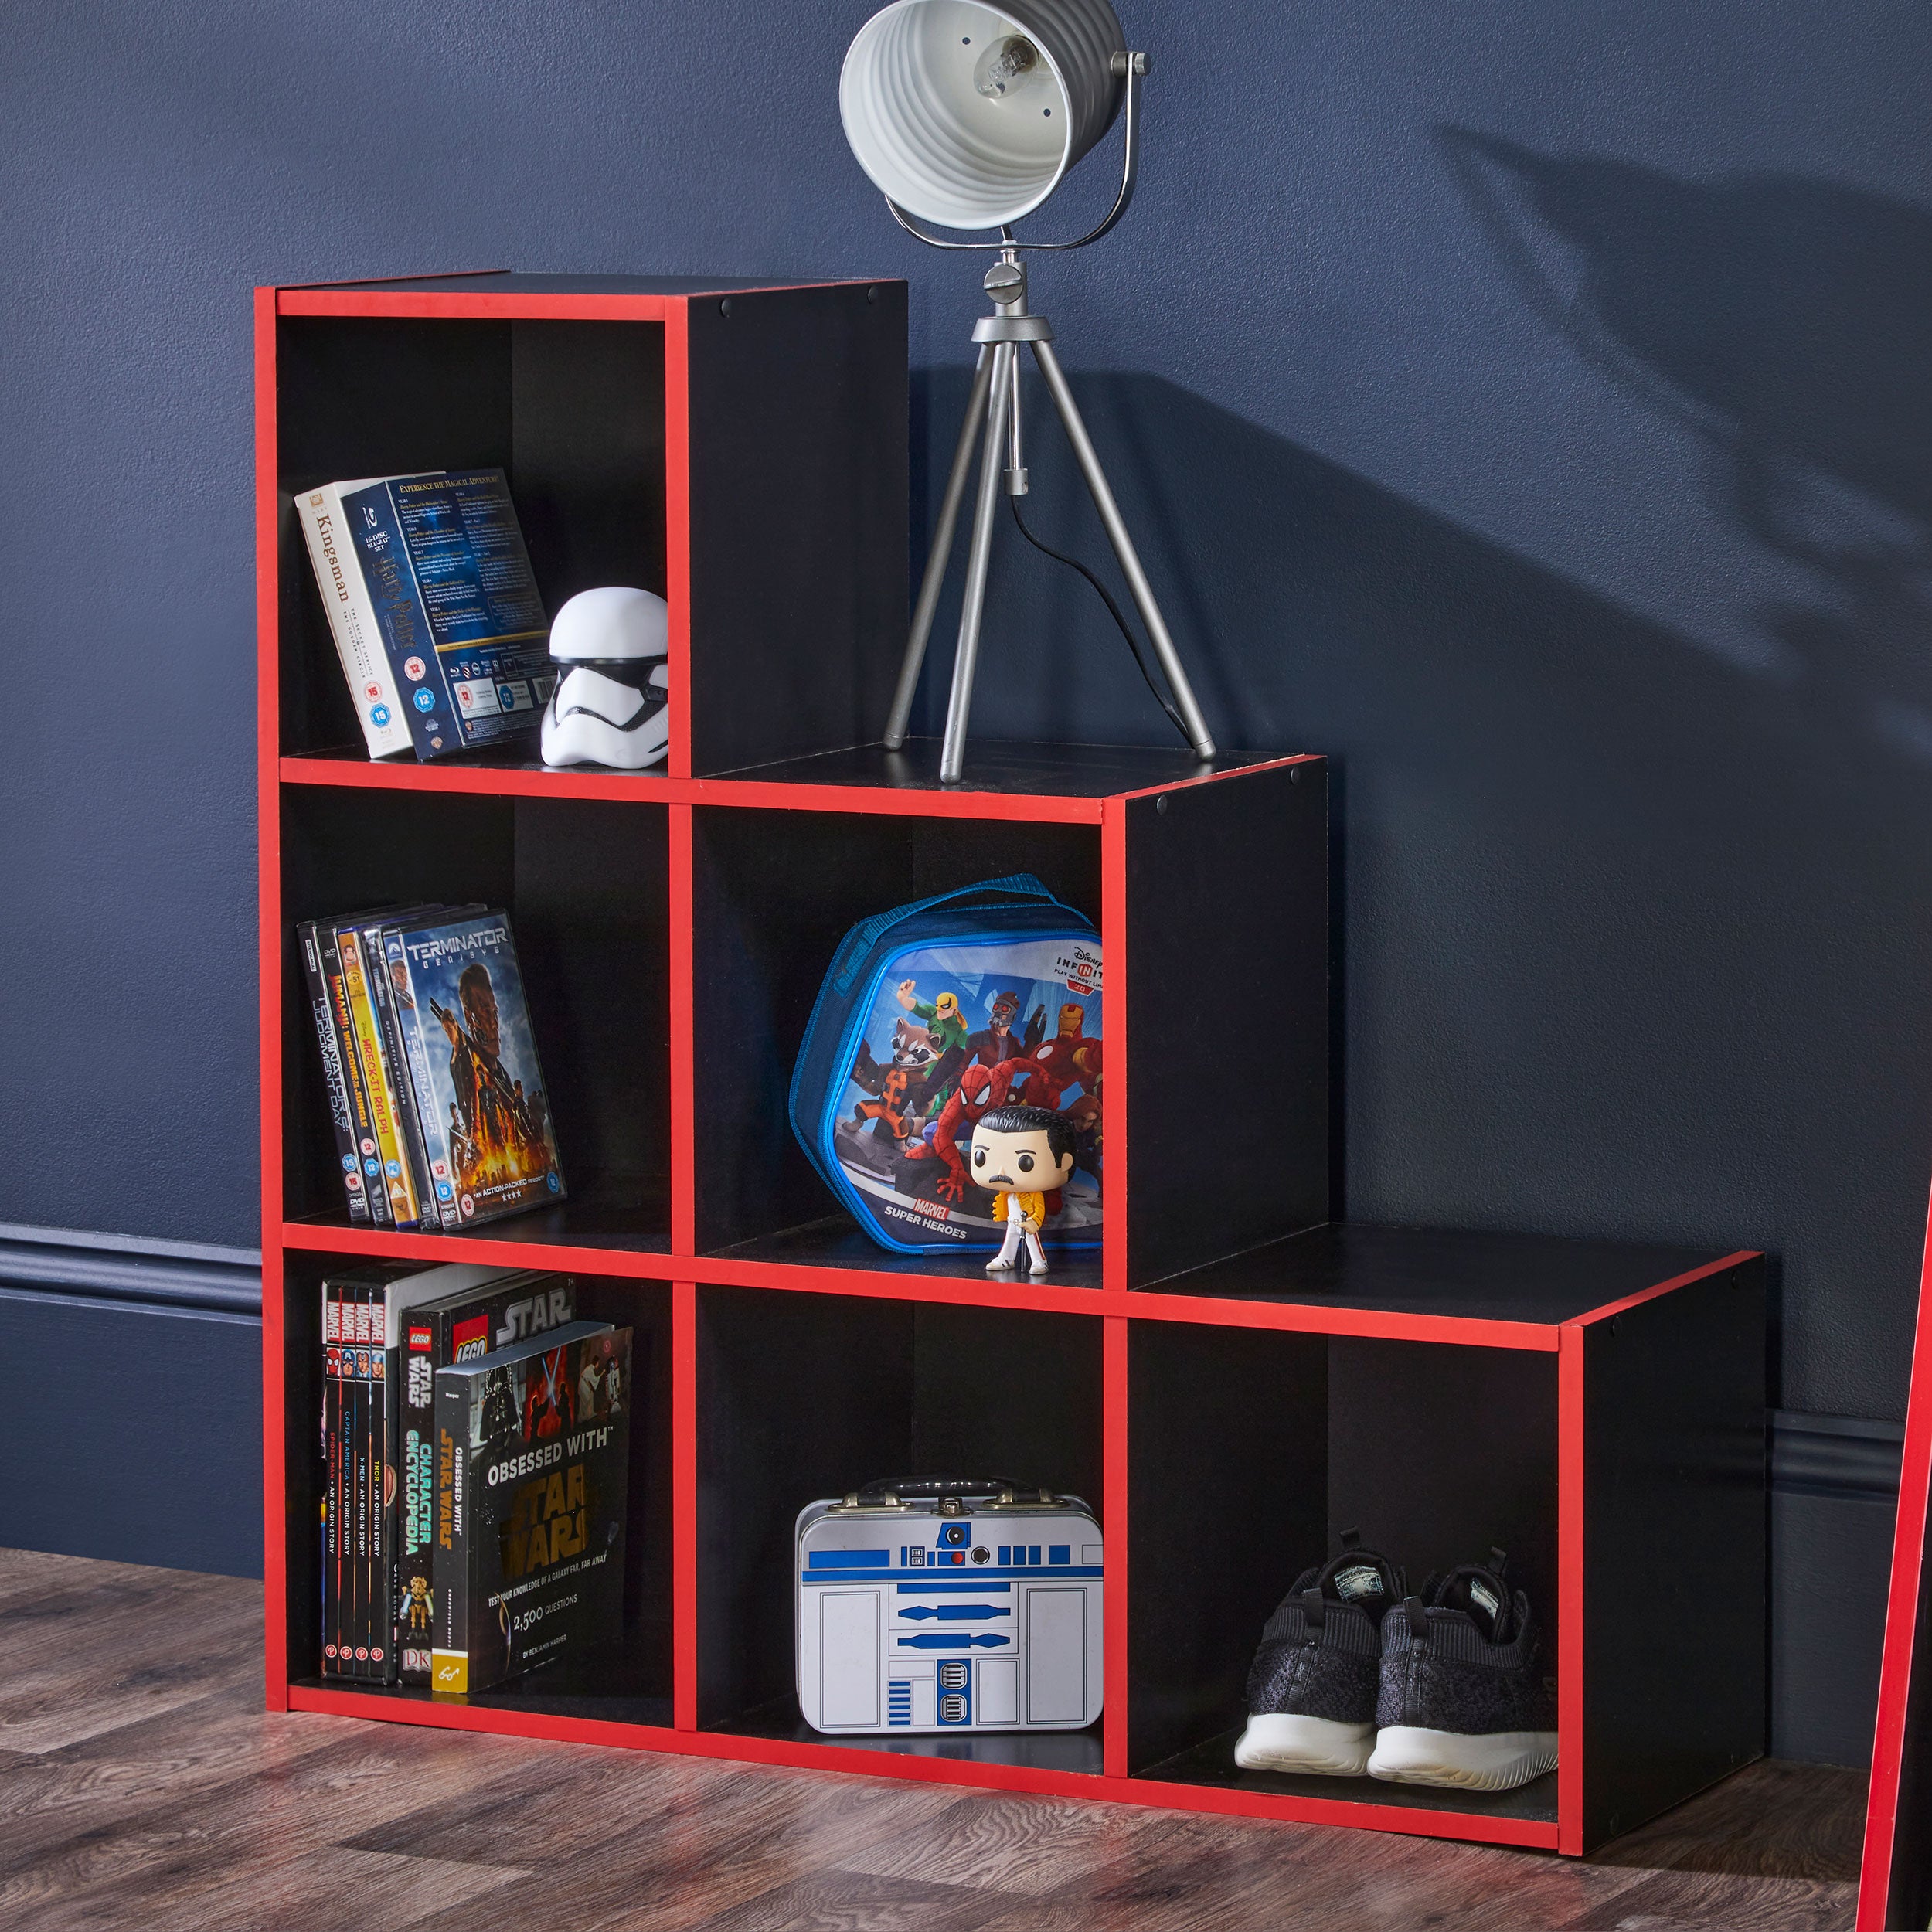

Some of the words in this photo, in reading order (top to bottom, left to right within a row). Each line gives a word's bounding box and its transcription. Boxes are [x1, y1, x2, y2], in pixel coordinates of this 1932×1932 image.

[399, 481, 434, 493] EXPERIENCE
[434, 481, 445, 489] THE
[444, 479, 468, 488] MAGICAL
[366, 531, 388, 543] 16-DISC
[316, 513, 349, 604] Kingsman
[372, 556, 403, 601] Harry
[385, 599, 418, 649] Potter
[368, 687, 378, 697] 15
[419, 695, 430, 706] 12
[503, 694, 511, 702] 12
[375, 710, 386, 721] 15
[406, 927, 509, 961] TERMINATOR
[423, 947, 500, 969] GENISYS
[1056, 957, 1103, 979] INFINIT
[1069, 974, 1092, 985] WITHOUT
[312, 1000, 335, 1090] JUDGMENT
[330, 1096, 342, 1127] DAY
[318, 996, 348, 1112] TERMINATOR
[328, 974, 349, 1029] JUMANJI:
[343, 1030, 359, 1080] WELCOME
[354, 1087, 368, 1128] JUNGLE
[385, 1019, 398, 1066] DEFINITIVE
[395, 1070, 406, 1105] EDITION
[362, 1039, 381, 1092] WRECK-IT
[374, 1097, 389, 1134] RALPH
[409, 1025, 438, 1137] TERMINATOR
[435, 1165, 444, 1175] 12
[483, 1179, 527, 1196] ACTION-PACKED
[550, 1178, 556, 1186] 12
[441, 1187, 448, 1196] 12
[465, 1200, 471, 1210] 12
[914, 1199, 947, 1220] MARVEL
[884, 1206, 922, 1225] SUPER
[922, 1218, 968, 1240] HEROES
[327, 1301, 339, 1339] MARVEL
[342, 1302, 355, 1341] MARVEL
[356, 1303, 369, 1342] MARVEL
[372, 1304, 385, 1342] MARVEL
[496, 1287, 572, 1345] STAR
[411, 1335, 430, 1344] LEGO
[408, 1356, 421, 1408] WARS
[420, 1356, 433, 1408] STAR
[440, 1428, 454, 1488] STAR
[454, 1447, 463, 1502] OBSESSED
[488, 1442, 562, 1487] OBSESSED
[329, 1486, 335, 1498] AN
[345, 1488, 350, 1499] AN
[359, 1488, 365, 1500] AN
[374, 1488, 379, 1500] AN
[406, 1430, 419, 1556] ENCYCLOPEDIA
[420, 1443, 432, 1543] CHARACTER
[500, 1463, 587, 1535] STAR
[439, 1490, 452, 1550] WARS
[500, 1509, 590, 1581] WARS
[488, 1595, 500, 1607] TEST
[500, 1590, 512, 1603] YOUR
[513, 1579, 540, 1597] KNOWLEDGE
[540, 1577, 548, 1585] OF
[552, 1566, 570, 1581] GALAXY
[570, 1563, 580, 1574] FAR,
[580, 1558, 591, 1570] FAR
[591, 1554, 607, 1566] AWAY
[513, 1607, 543, 1631] 2,500
[544, 1594, 578, 1615] QUESTIONS
[406, 1650, 430, 1667] DK
[522, 1650, 529, 1658] BY
[529, 1641, 550, 1656] BENJAMIN
[549, 1634, 567, 1647] HARPER
